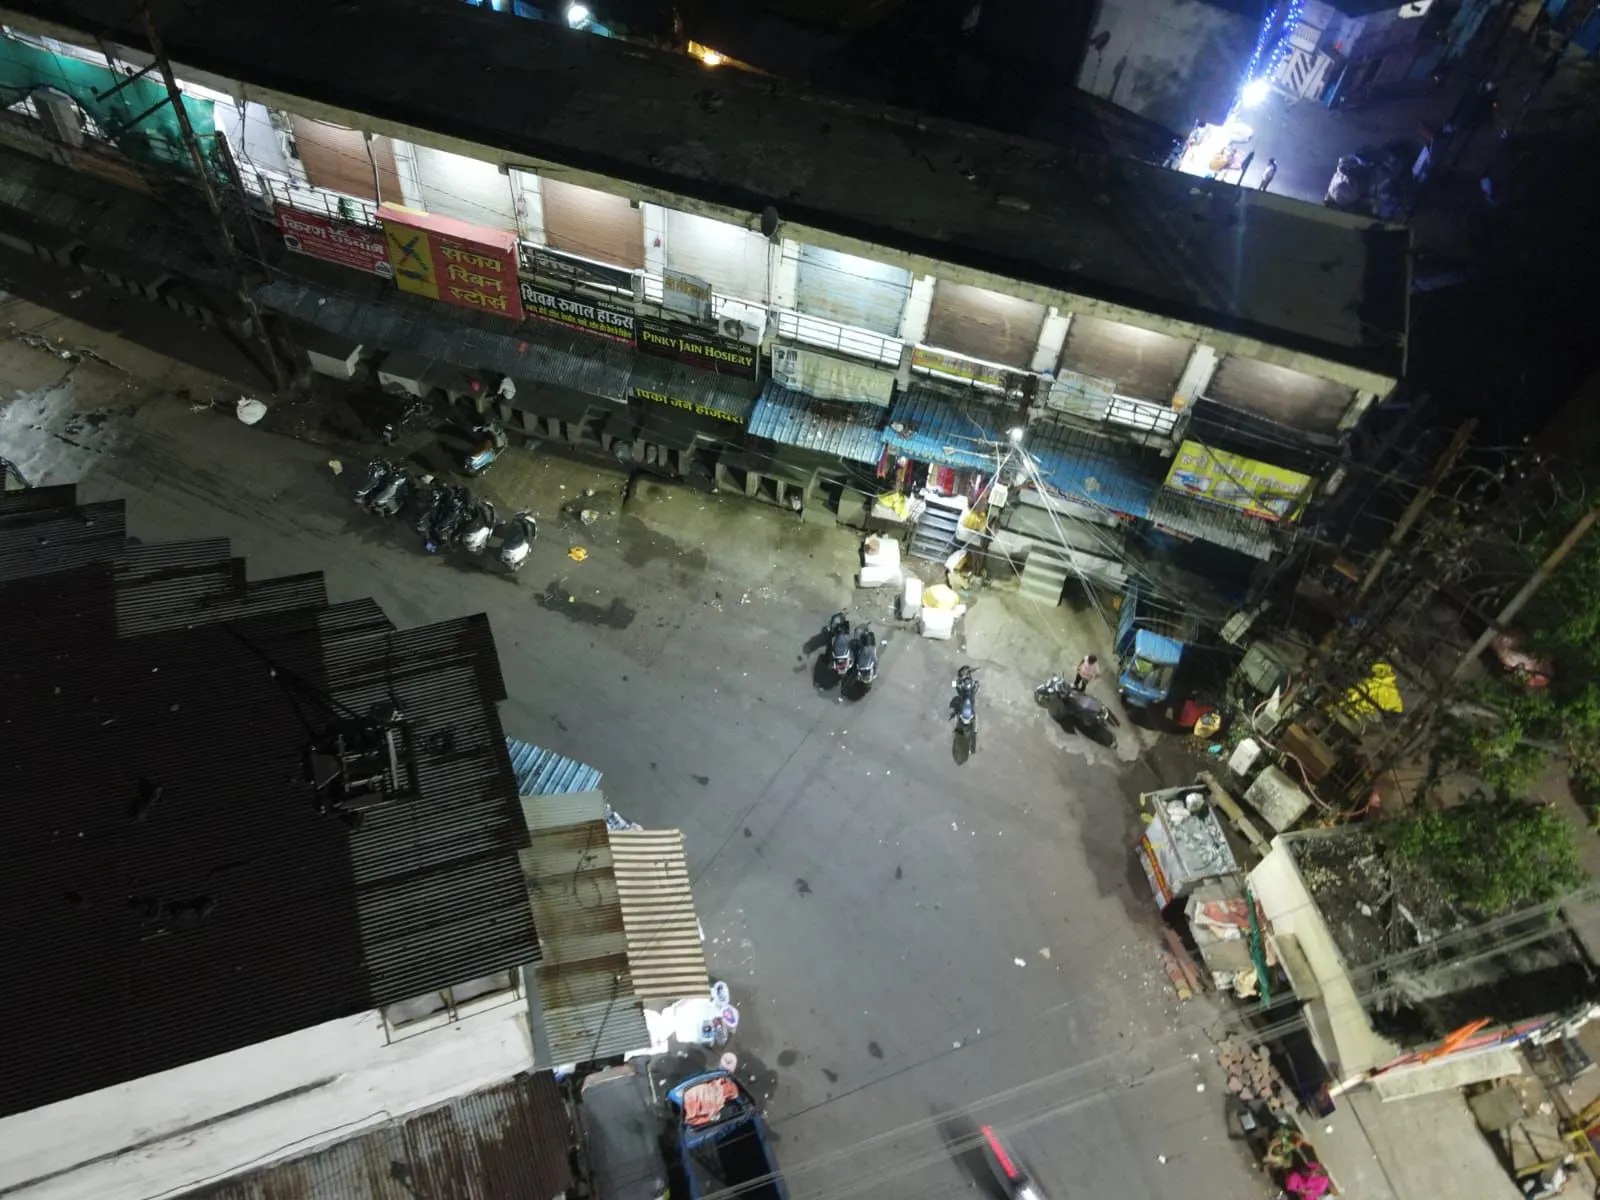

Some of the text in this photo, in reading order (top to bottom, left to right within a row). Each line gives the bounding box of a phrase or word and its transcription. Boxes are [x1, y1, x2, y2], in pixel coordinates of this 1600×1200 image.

[281, 214, 327, 239] किरण
[556, 296, 594, 318] रुमाल
[597, 307, 634, 330] हाऊस
[642, 331, 677, 348] PINKY
[678, 339, 702, 355] JAIN
[704, 343, 753, 367] HOSIERY
